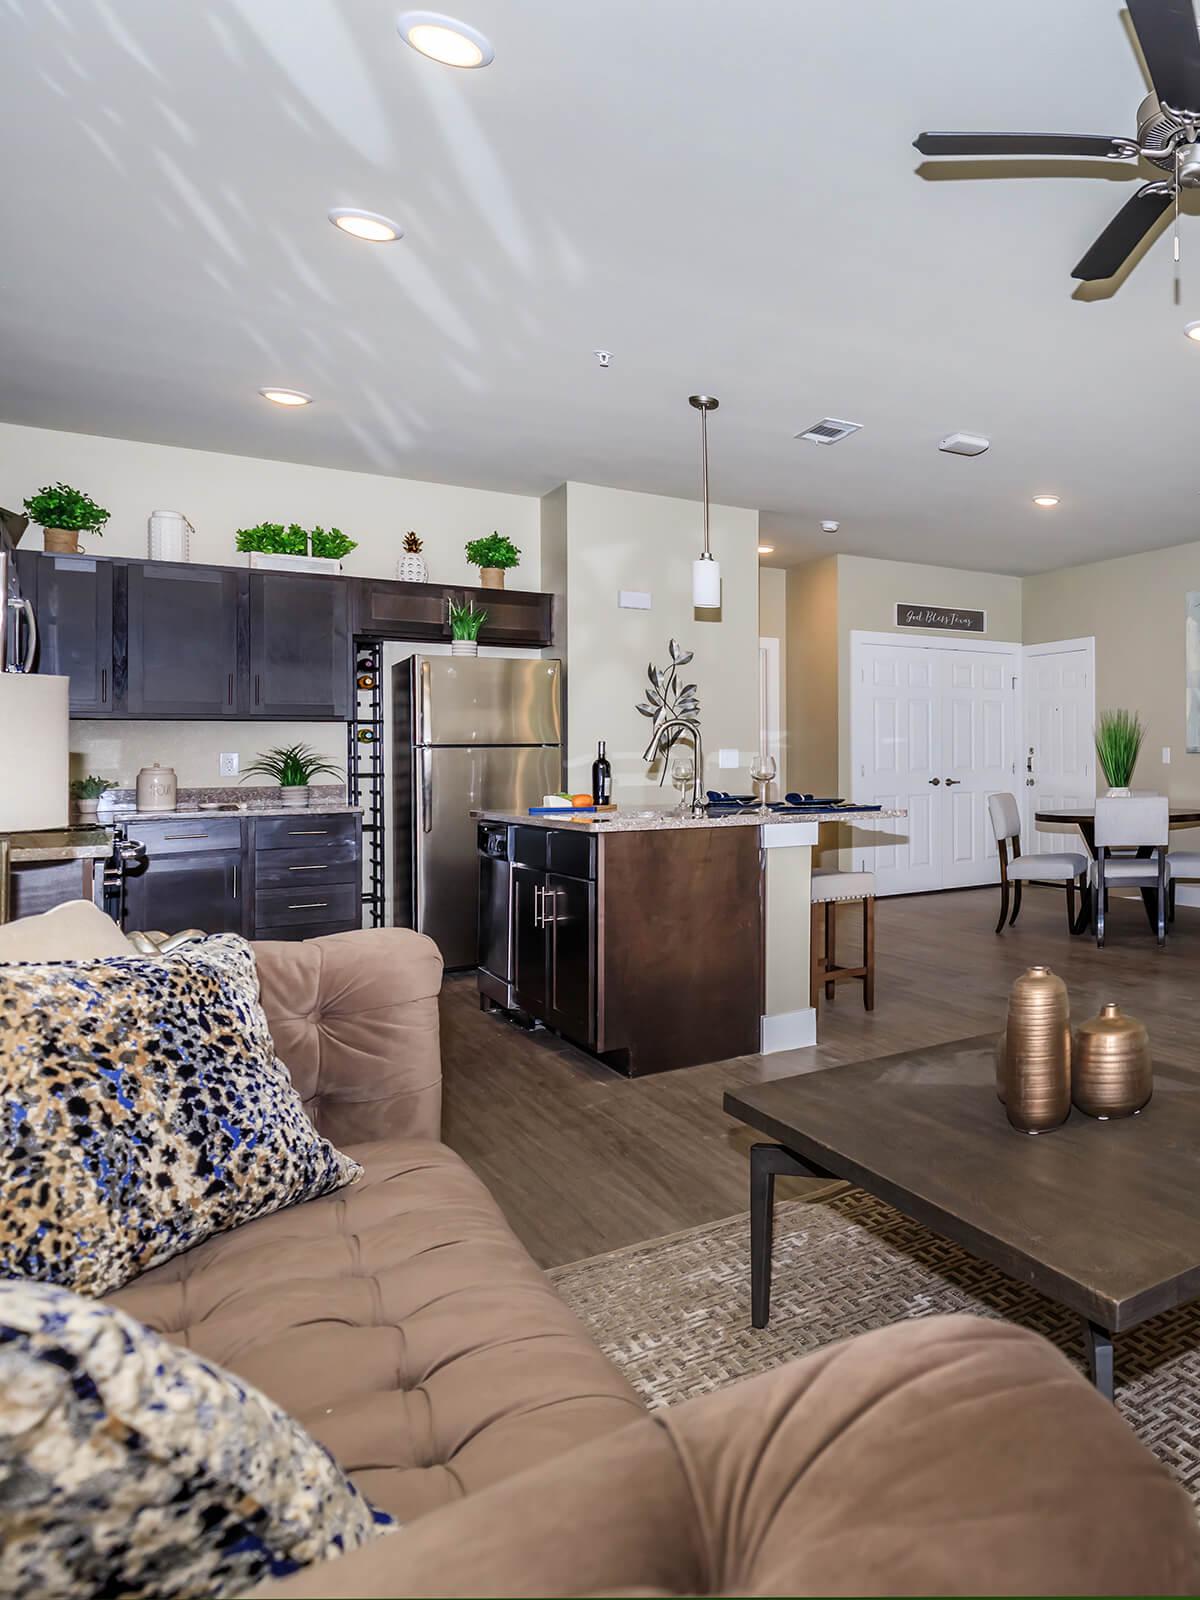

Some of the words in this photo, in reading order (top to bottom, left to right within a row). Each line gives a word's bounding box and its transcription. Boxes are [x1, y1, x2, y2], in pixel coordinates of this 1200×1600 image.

[905, 609, 922, 623] God
[925, 610, 948, 624] Bless
[949, 612, 974, 626] Texas
